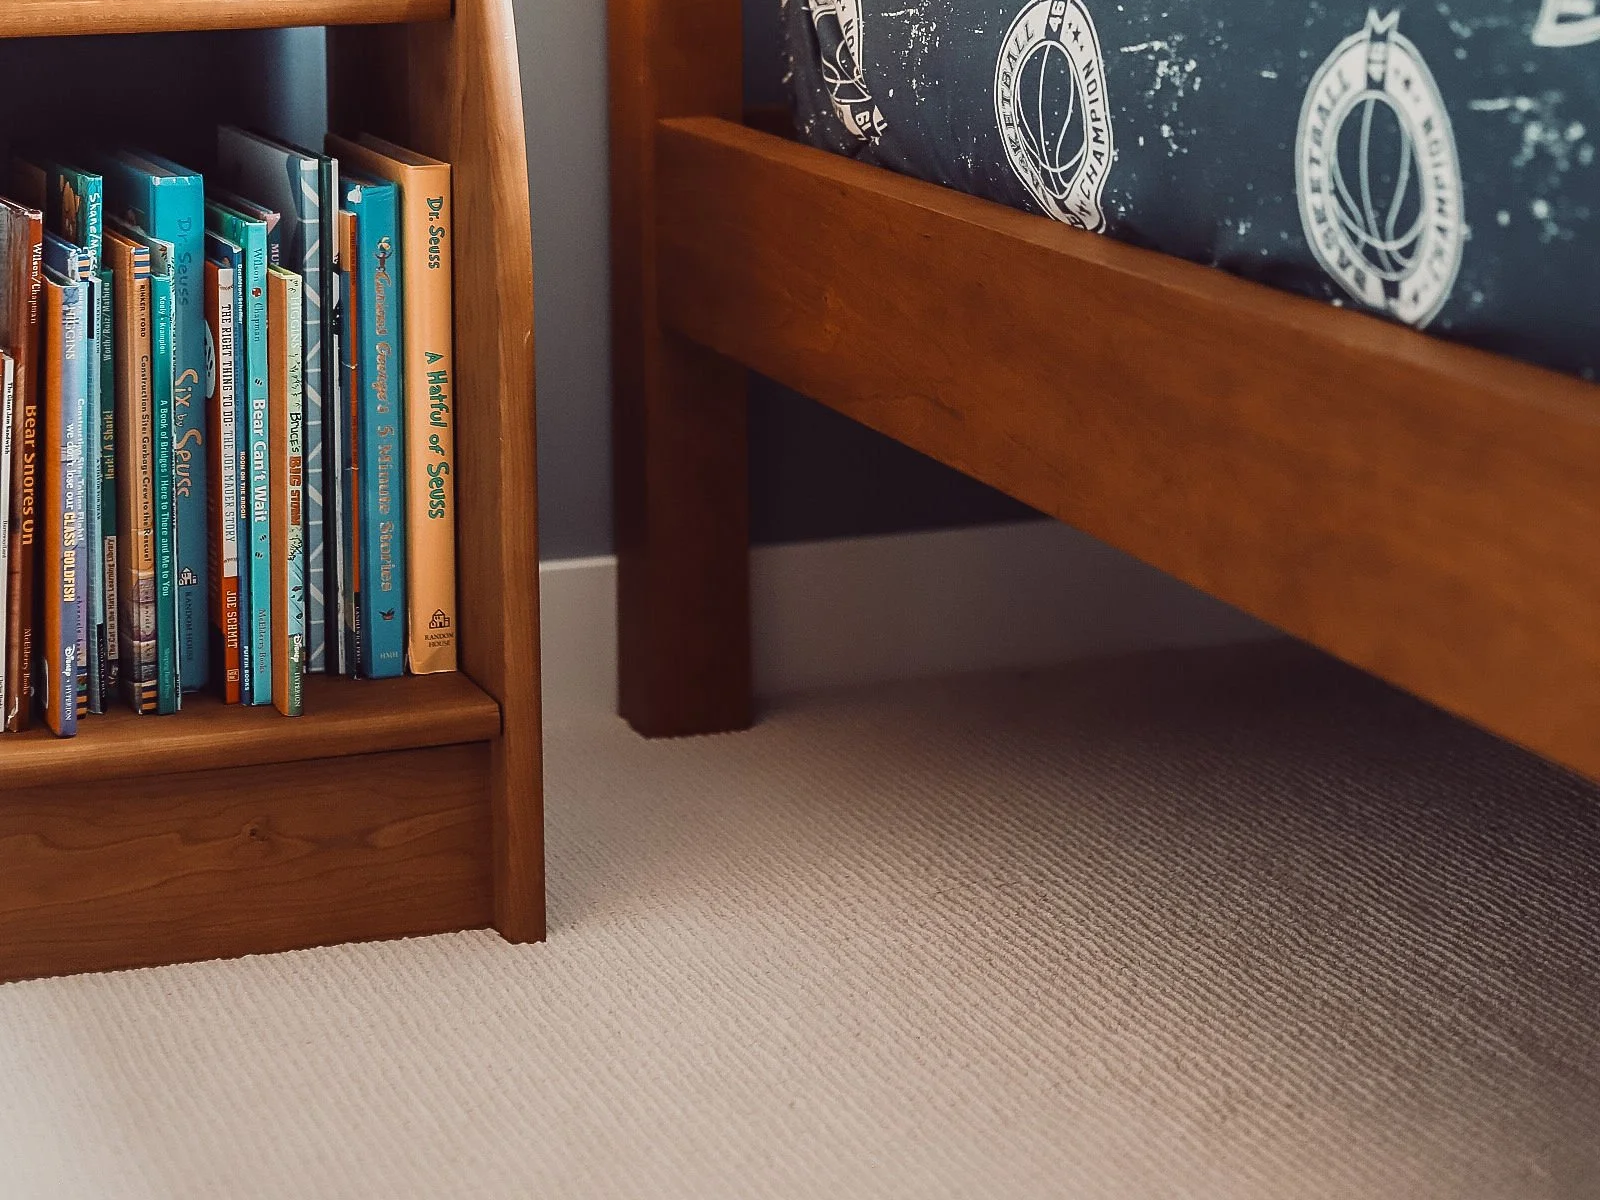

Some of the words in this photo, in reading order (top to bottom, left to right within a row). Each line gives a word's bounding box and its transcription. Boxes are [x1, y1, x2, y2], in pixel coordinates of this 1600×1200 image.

[1049, 0, 1066, 32] 46
[1077, 58, 1105, 202] CHAMPION
[427, 198, 443, 222] Dr.
[178, 217, 191, 245] Dr.
[428, 226, 443, 269] Seuss
[178, 252, 192, 306] Seuss
[253, 249, 262, 282] Wilson
[29, 243, 42, 323] Wilson/Chapman
[222, 304, 231, 323] THE
[376, 272, 391, 335] Curious
[65, 308, 75, 359] HIGGINS
[252, 303, 262, 342] Chapman
[291, 296, 300, 348] HIGGINS
[222, 328, 232, 356] RIGHT
[424, 351, 443, 364] A
[141, 355, 149, 411] Construction
[174, 369, 198, 407] Six
[223, 361, 232, 391] THING
[372, 342, 391, 413] George's
[224, 396, 232, 407] TO
[427, 371, 448, 427] Hatful
[25, 405, 36, 447] Bear
[67, 424, 74, 438] we
[160, 408, 168, 428] Book
[176, 414, 187, 426] by
[224, 411, 233, 426] DO:
[253, 399, 265, 439] Bear
[378, 425, 395, 437] 5
[66, 441, 76, 467] don't
[140, 437, 150, 474] Garbage
[224, 431, 233, 450] THE
[429, 434, 444, 456] of
[160, 441, 169, 472] Bridges
[176, 429, 202, 498] Seuss
[224, 454, 234, 471] JOE
[254, 441, 267, 480] Can't
[290, 456, 301, 486] BIG
[23, 453, 35, 515] Snores
[66, 470, 76, 488] lose
[142, 477, 150, 498] Crew
[161, 481, 169, 499] Here
[224, 474, 234, 508] MAUER
[378, 445, 393, 514] Minute
[427, 462, 448, 519] Seuss
[143, 501, 150, 511] to
[255, 486, 267, 522] Wait
[291, 489, 300, 526] STORM
[23, 520, 33, 545] On
[64, 512, 75, 546] CLASS
[161, 512, 170, 535] There
[225, 511, 235, 542] STORY
[161, 538, 170, 553] and
[379, 521, 395, 592] Stories
[64, 550, 75, 601] GOLDFISH
[162, 556, 170, 568] Me
[162, 581, 171, 596] You
[226, 591, 236, 608] JOE
[185, 591, 193, 628] RANDOM
[227, 611, 237, 648] SCHMIT
[258, 609, 266, 649] McElderry
[424, 632, 454, 641] RANDOM
[429, 640, 450, 648] HOUSE
[62, 644, 75, 676] Disney
[186, 631, 194, 661] HOUSE
[291, 634, 302, 663] Disney
